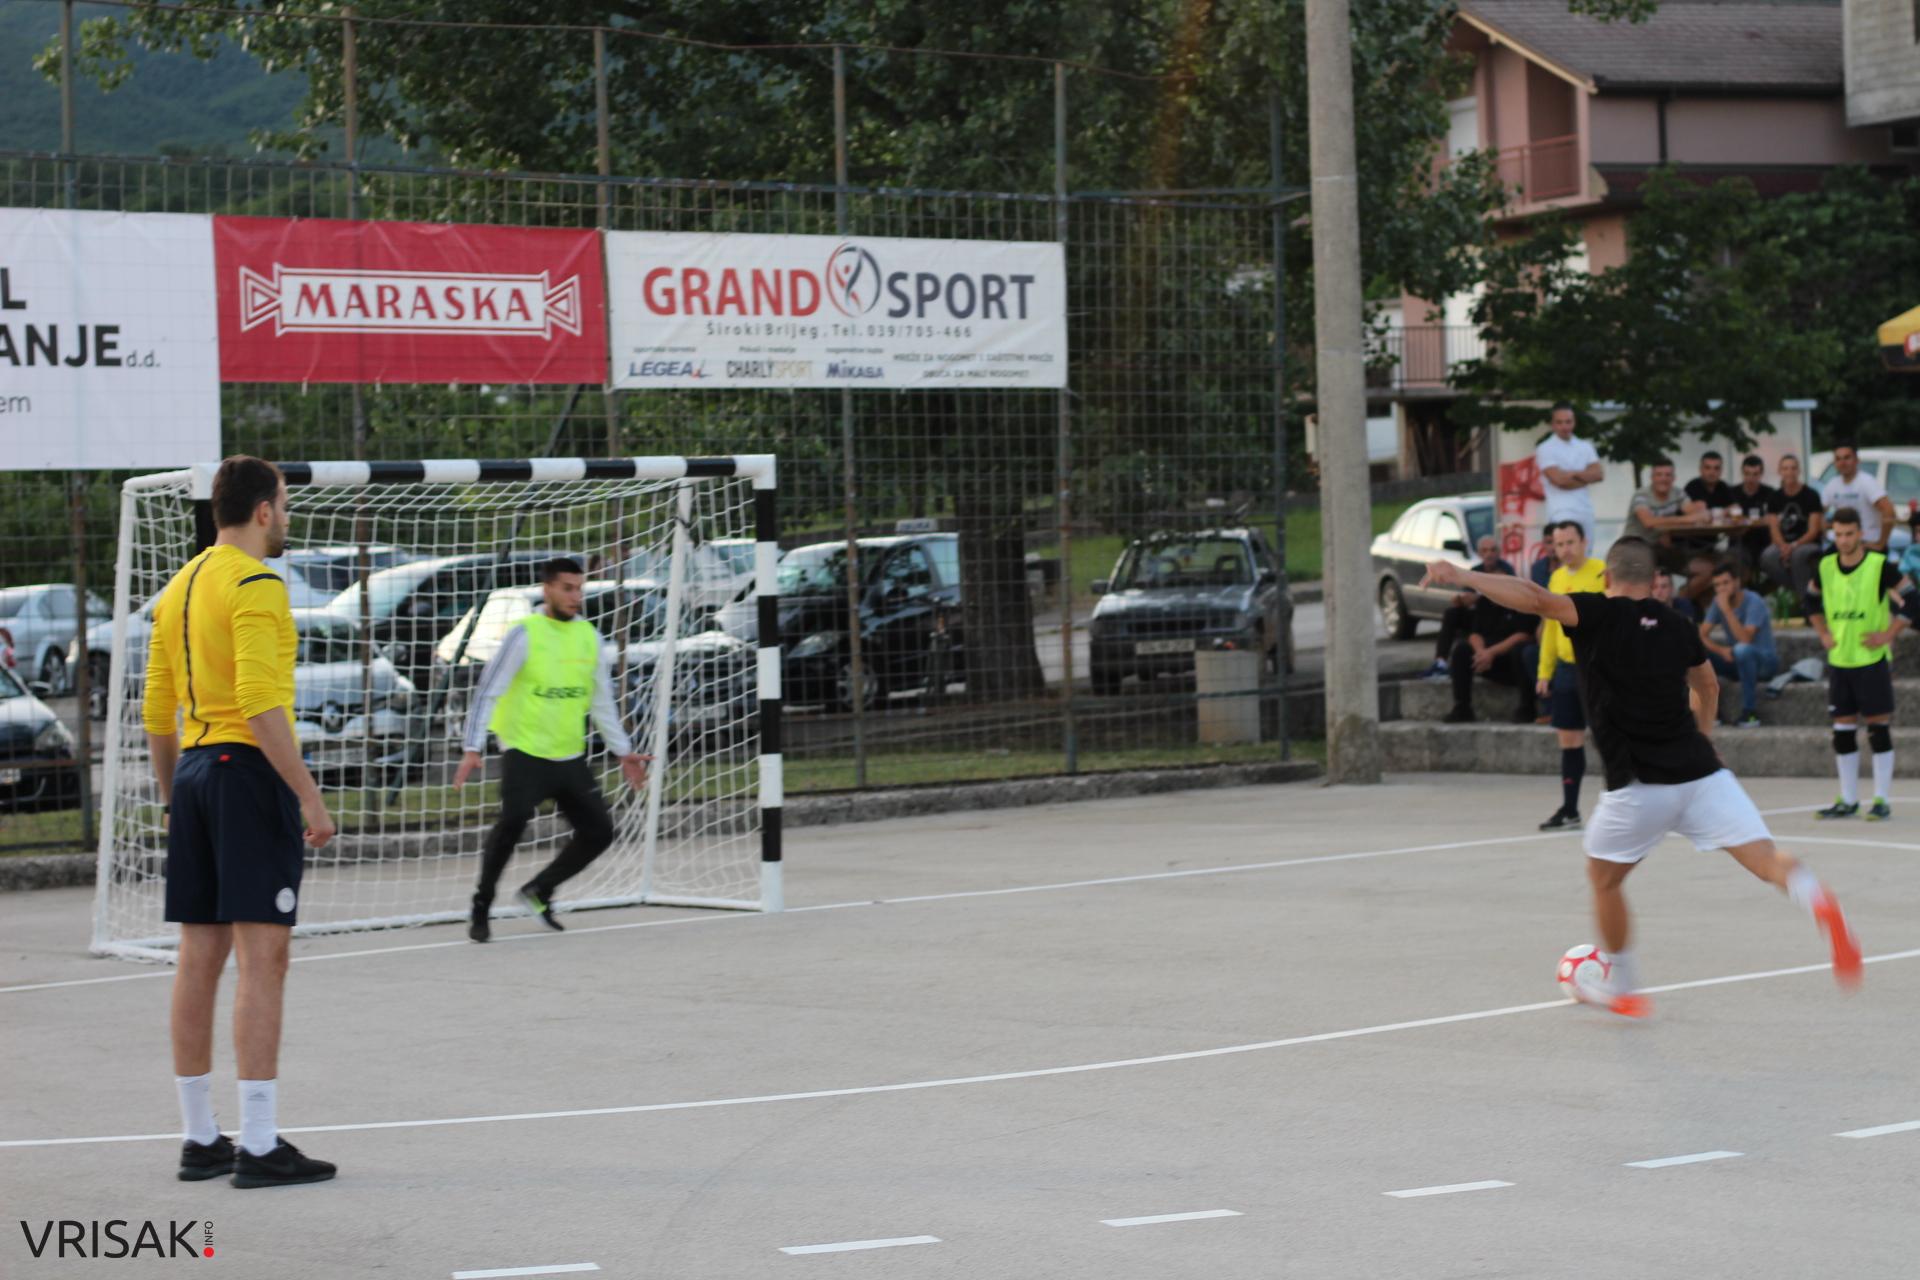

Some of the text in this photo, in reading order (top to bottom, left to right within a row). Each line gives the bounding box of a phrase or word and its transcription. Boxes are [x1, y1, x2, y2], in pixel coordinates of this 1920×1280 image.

[0, 267, 27, 310] L
[294, 283, 533, 321] MARASKA
[642, 266, 1036, 320] GRAND SPORT
[0, 323, 122, 368] ANJE
[628, 361, 693, 377] LEGEA
